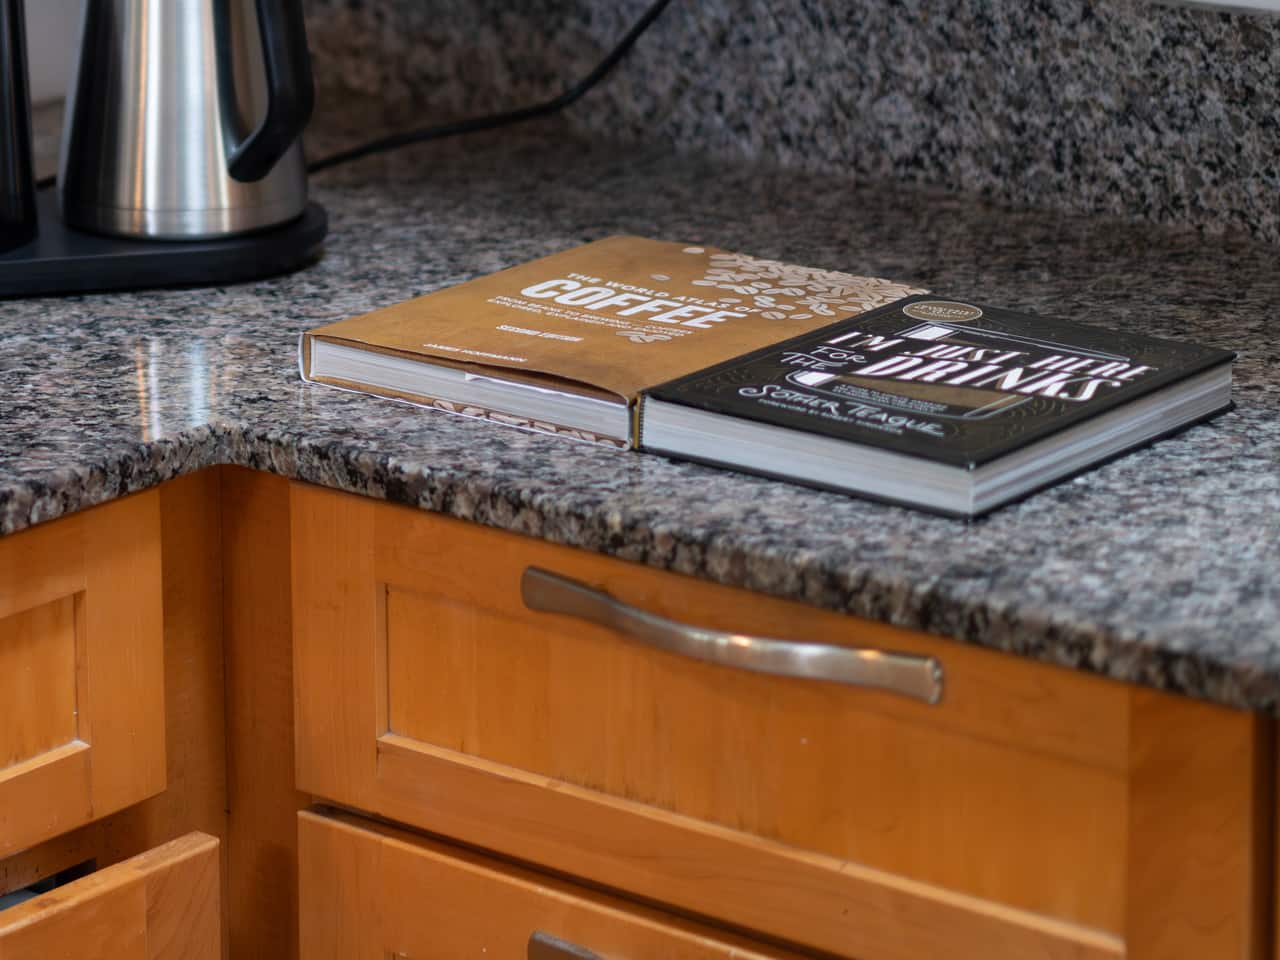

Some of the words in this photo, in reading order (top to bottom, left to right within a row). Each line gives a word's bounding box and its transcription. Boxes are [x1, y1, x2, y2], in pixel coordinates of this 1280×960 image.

[520, 279, 748, 329] COFFEE
[567, 273, 603, 284] THE
[605, 280, 670, 297] WORLD
[672, 295, 731, 309] ATLAS
[779, 351, 833, 371] THE
[810, 345, 867, 364] FOR
[904, 343, 1030, 364] JUST
[1024, 354, 1159, 381] HERE
[851, 355, 1122, 402] DRINKS
[845, 401, 946, 438] TEAGUE
